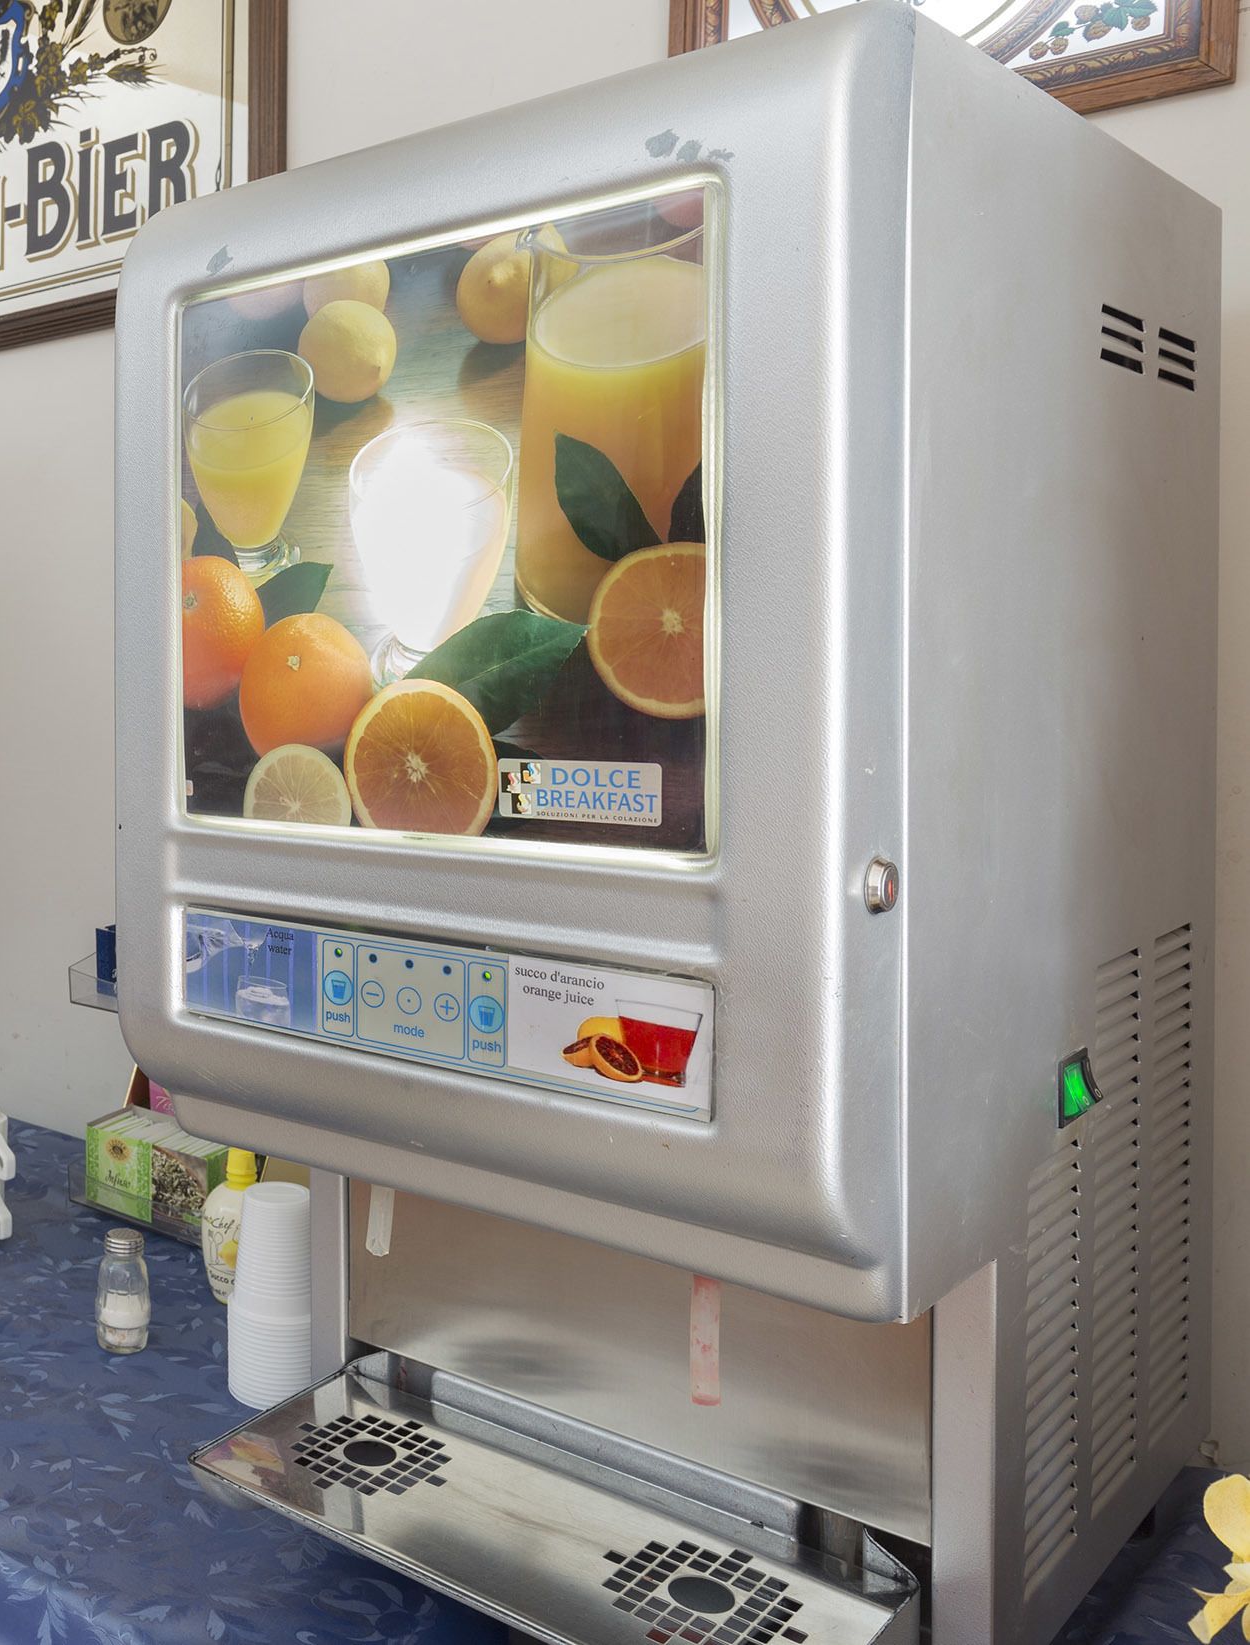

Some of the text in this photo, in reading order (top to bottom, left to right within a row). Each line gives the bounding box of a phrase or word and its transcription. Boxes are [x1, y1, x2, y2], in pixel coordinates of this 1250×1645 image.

[551, 767, 642, 789] DOLCE
[536, 789, 658, 814] BREAKFAST
[536, 811, 578, 819] SOLUZIONI
[613, 816, 658, 824] COLAZIONE
[266, 928, 294, 942] Acqua
[268, 945, 292, 956] water
[515, 966, 605, 990] succo d'arancio
[523, 984, 595, 1006] orange juice
[326, 1010, 350, 1023] push
[393, 1023, 425, 1038] mode
[472, 1039, 502, 1053] push
